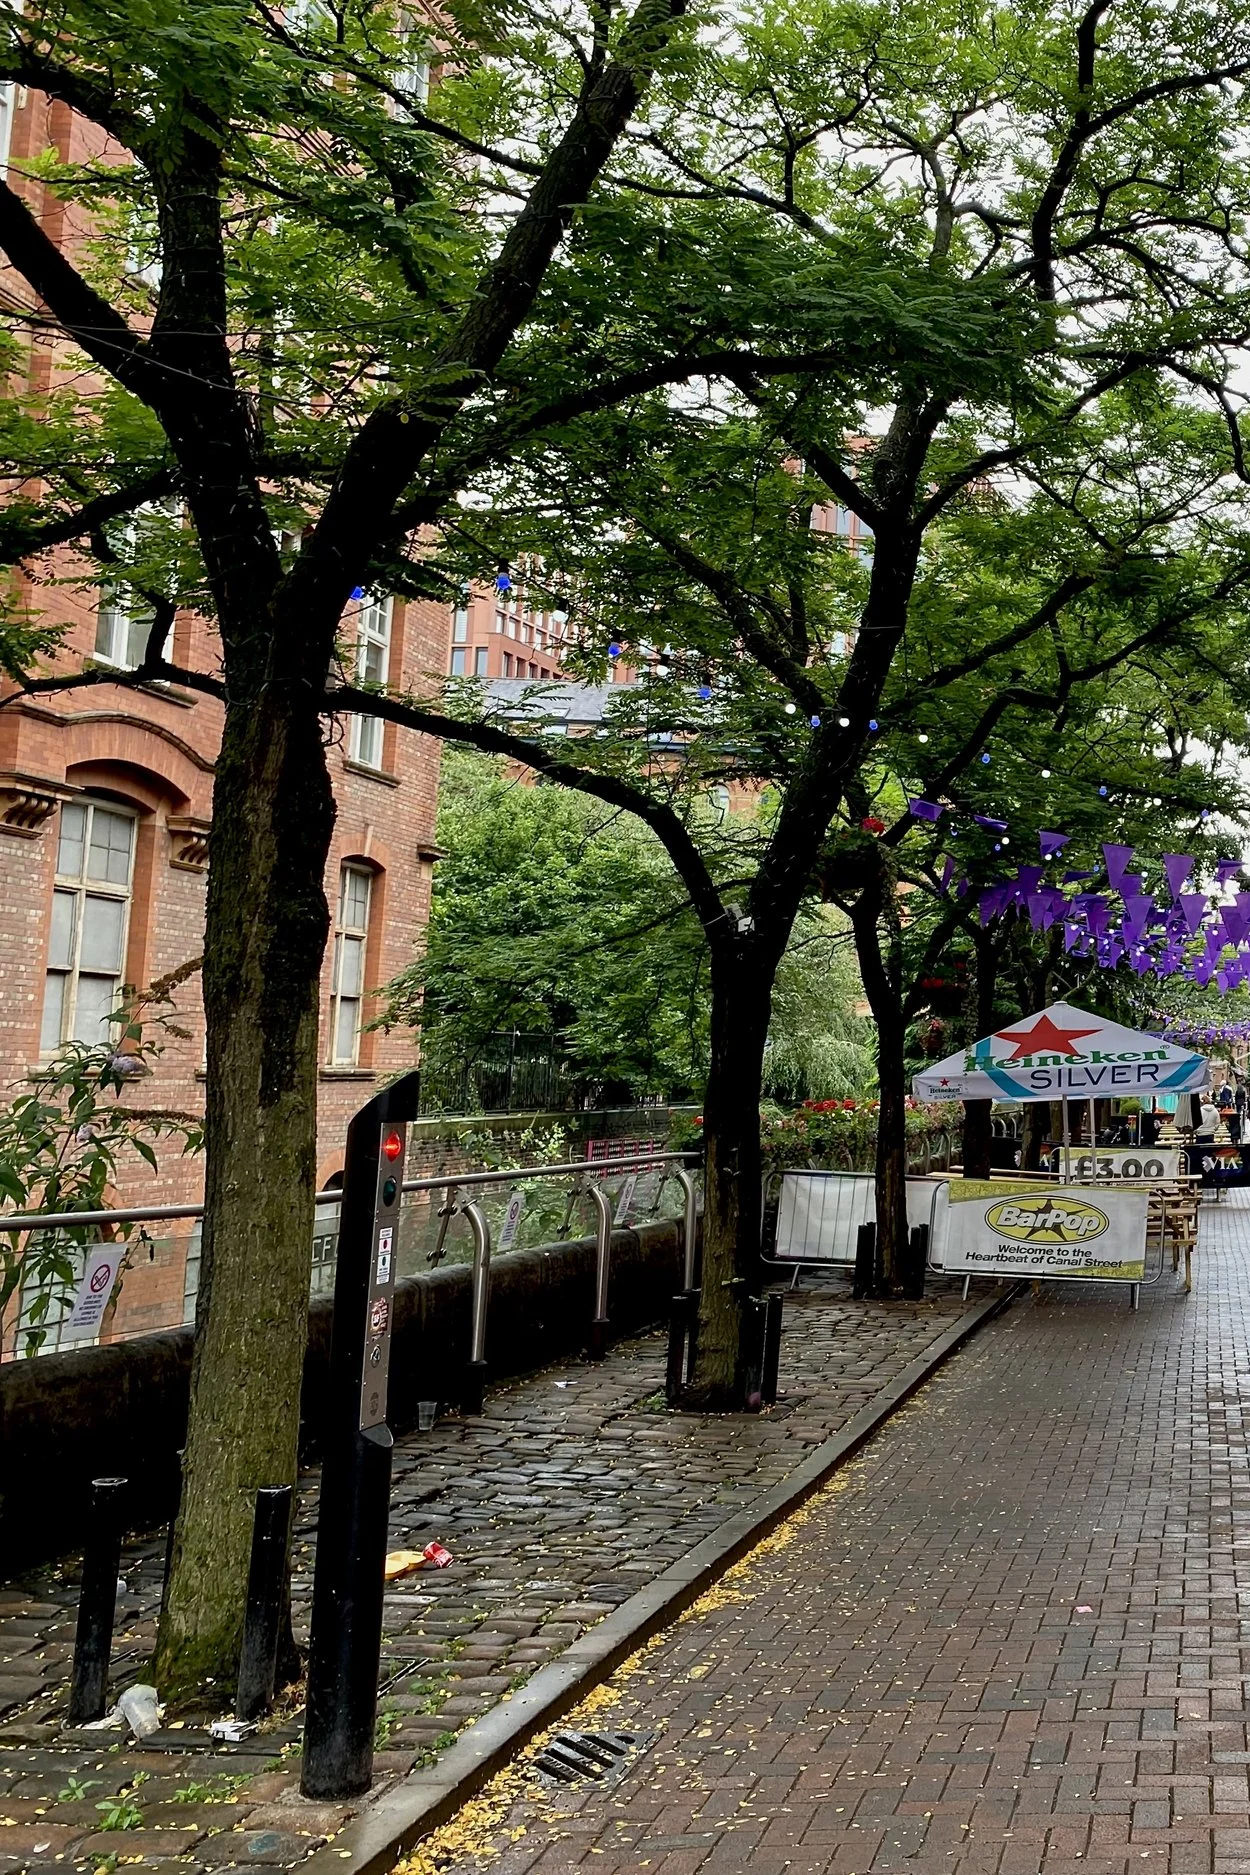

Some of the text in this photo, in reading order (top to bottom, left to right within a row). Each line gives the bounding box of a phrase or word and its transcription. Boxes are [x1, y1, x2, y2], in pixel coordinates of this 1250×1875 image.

[964, 1047, 1170, 1072] Heineken
[1030, 1064, 1160, 1090] SILVER
[1075, 1156, 1164, 1180] £3.00
[1208, 1156, 1239, 1170] VIA
[997, 1206, 1100, 1237] BarPop
[965, 1252, 1123, 1268] Heartbeat of Canal Street
[998, 1244, 1092, 1258] Welcome to the
